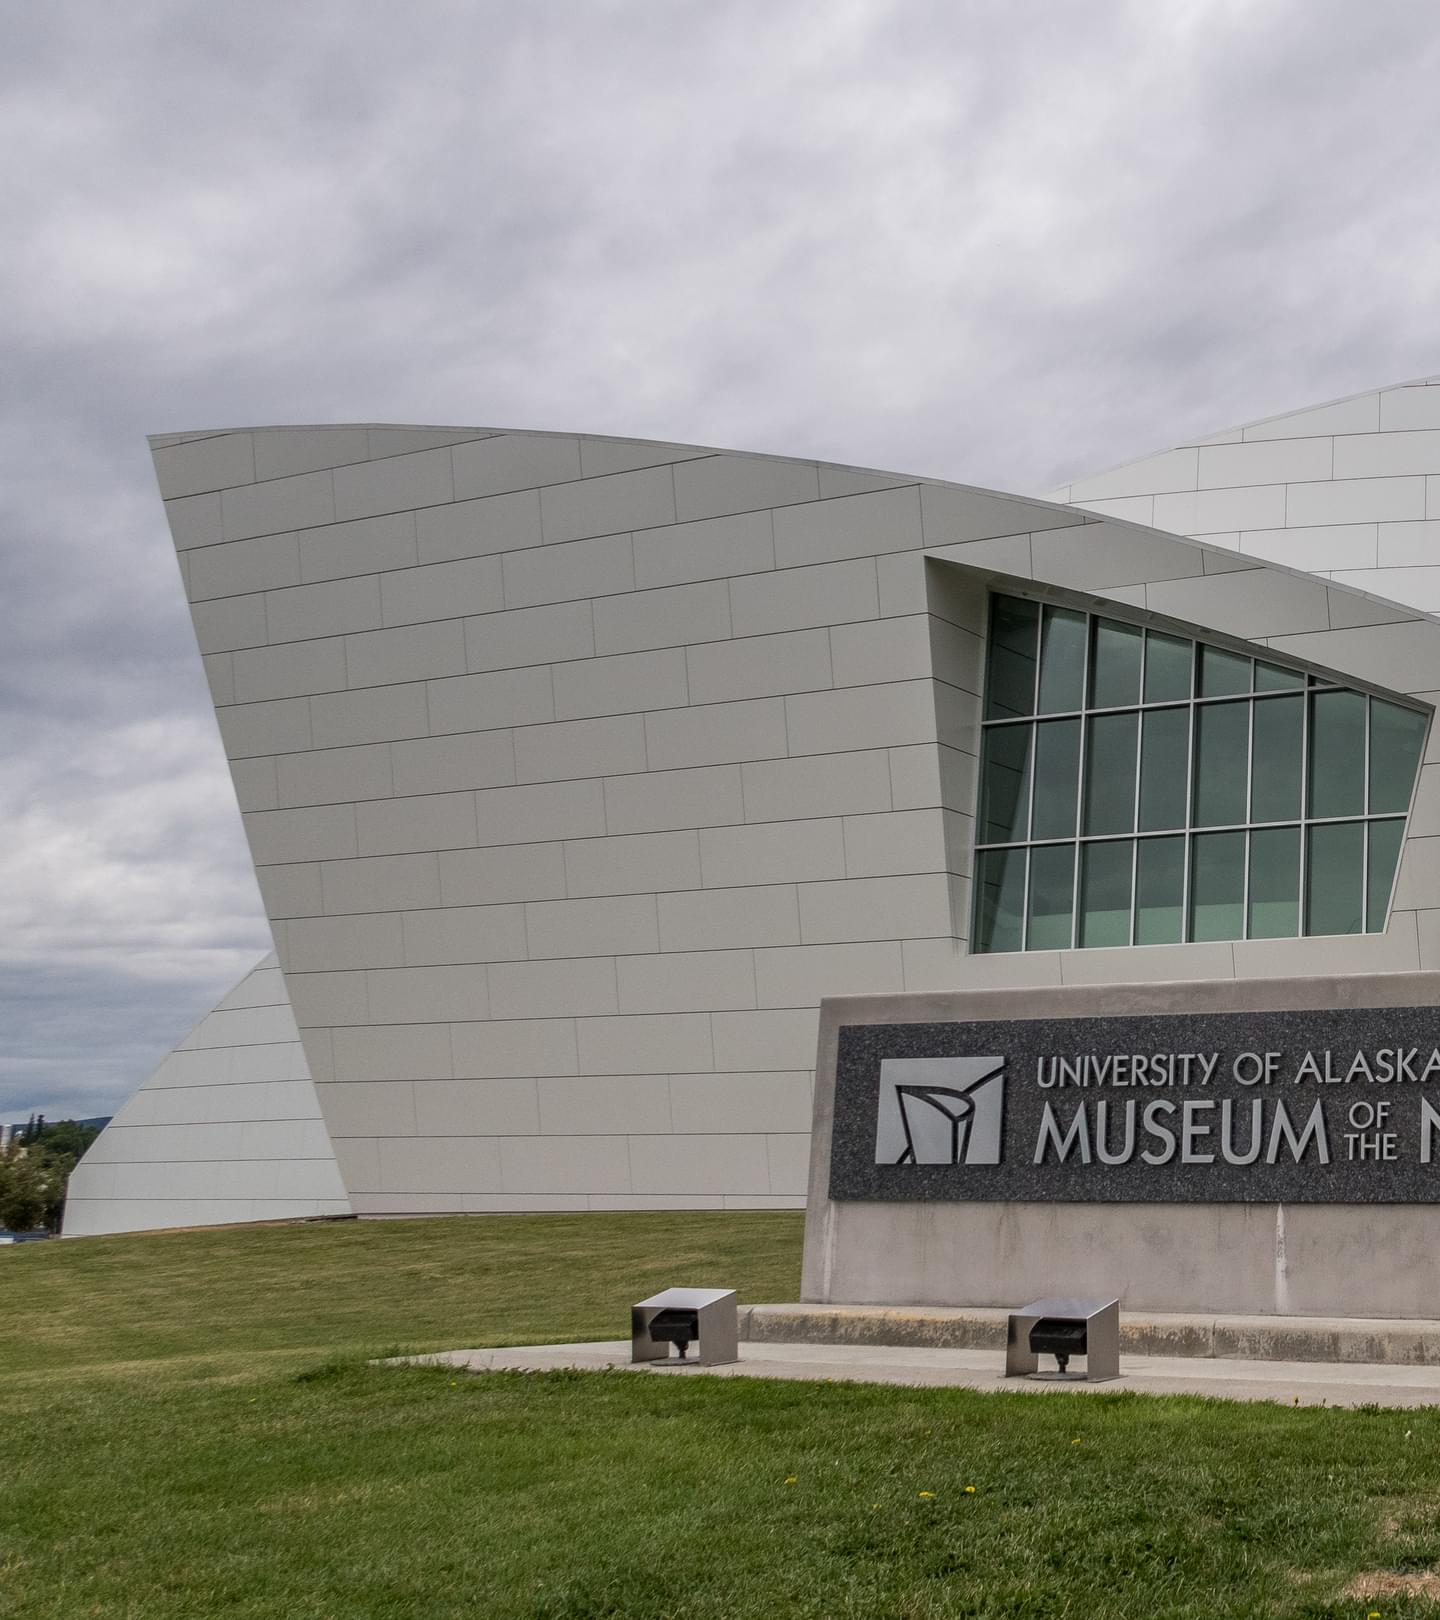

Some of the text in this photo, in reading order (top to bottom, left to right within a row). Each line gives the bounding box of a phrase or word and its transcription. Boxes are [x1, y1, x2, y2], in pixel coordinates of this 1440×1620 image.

[1037, 1053, 1219, 1088] UNIVERSITY
[1233, 1052, 1282, 1087] OF
[1033, 1098, 1329, 1165] MUSEUM
[1348, 1100, 1392, 1130] OF
[1344, 1133, 1399, 1162] THE
